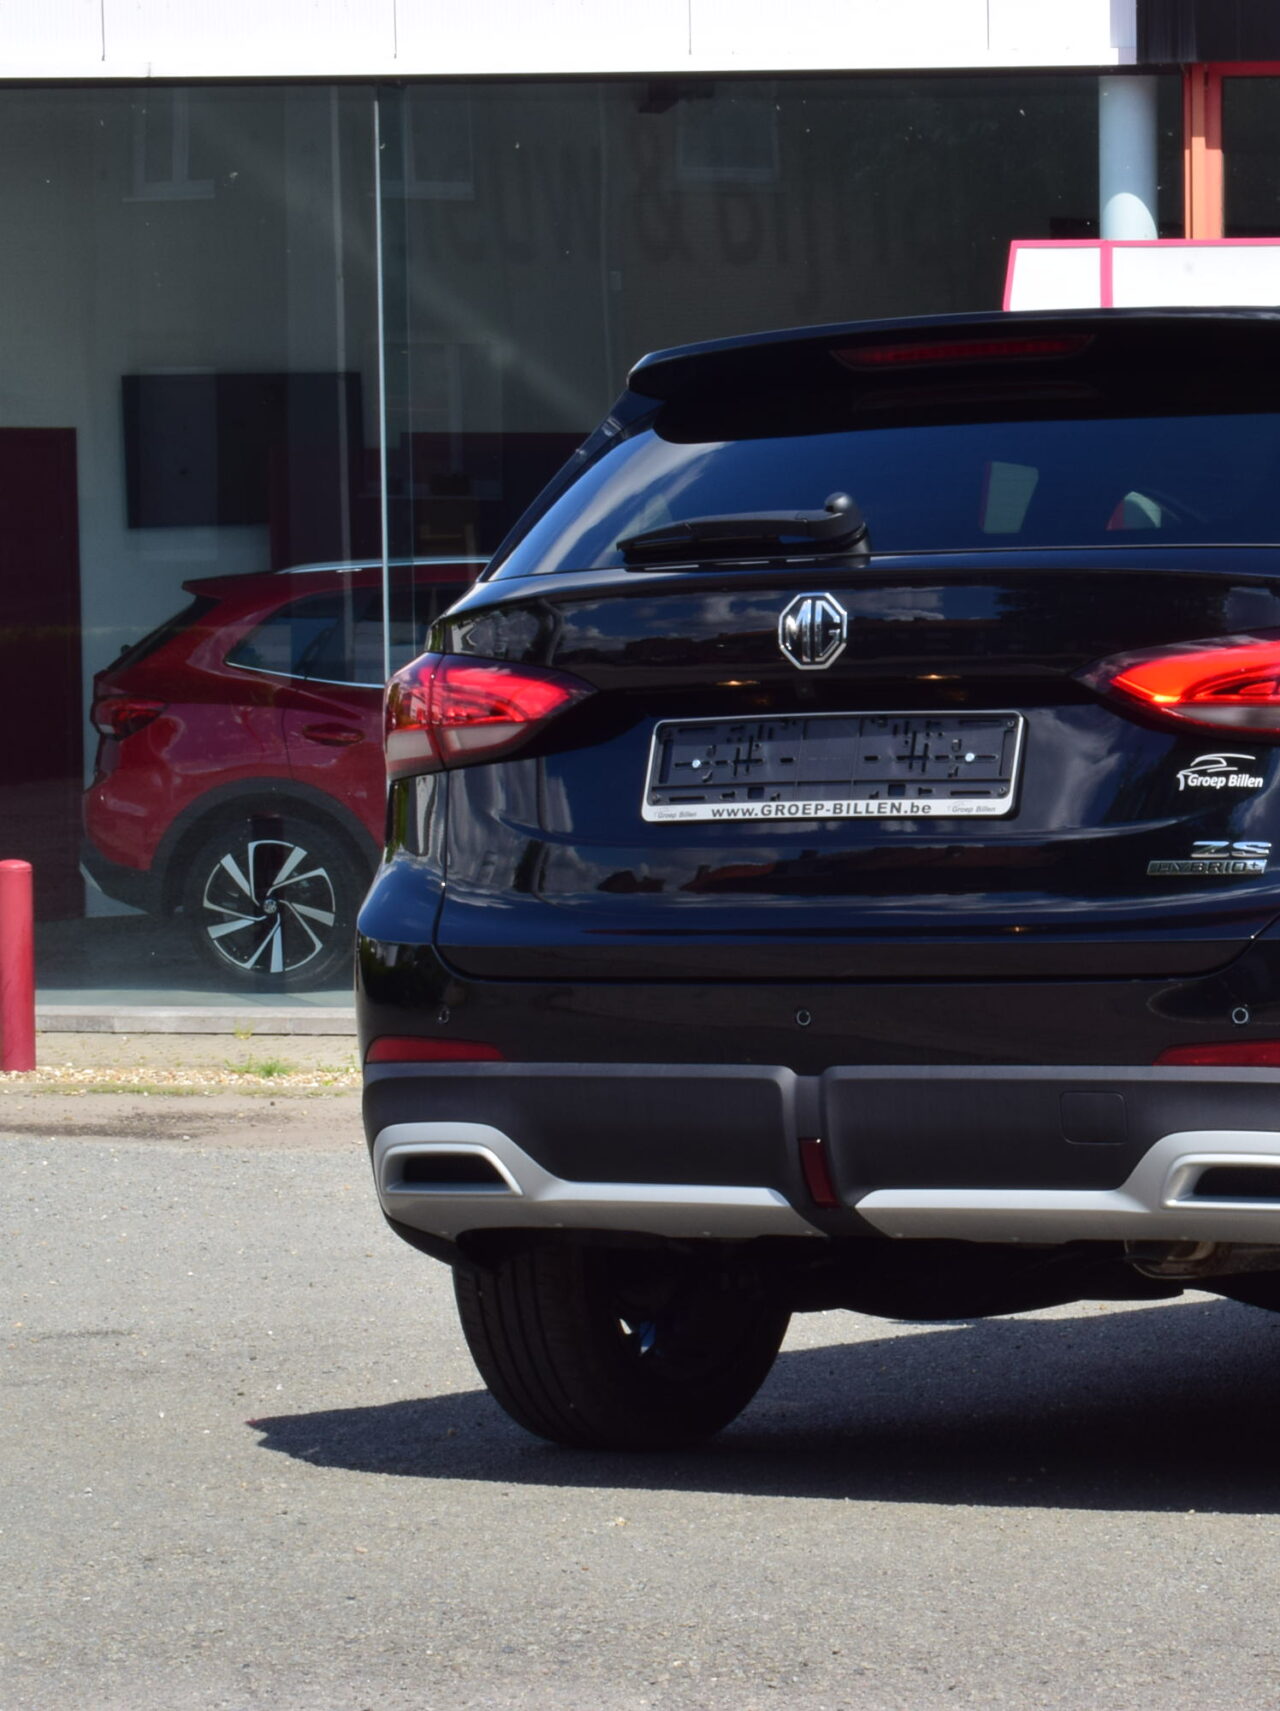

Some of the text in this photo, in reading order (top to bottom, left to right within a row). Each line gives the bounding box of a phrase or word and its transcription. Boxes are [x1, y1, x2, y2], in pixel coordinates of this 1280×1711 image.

[785, 598, 842, 663] MG
[1188, 773, 1263, 789] Groep Billen
[711, 802, 932, 818] www.GROEP-BILLEN.be
[1191, 841, 1272, 858] ZS
